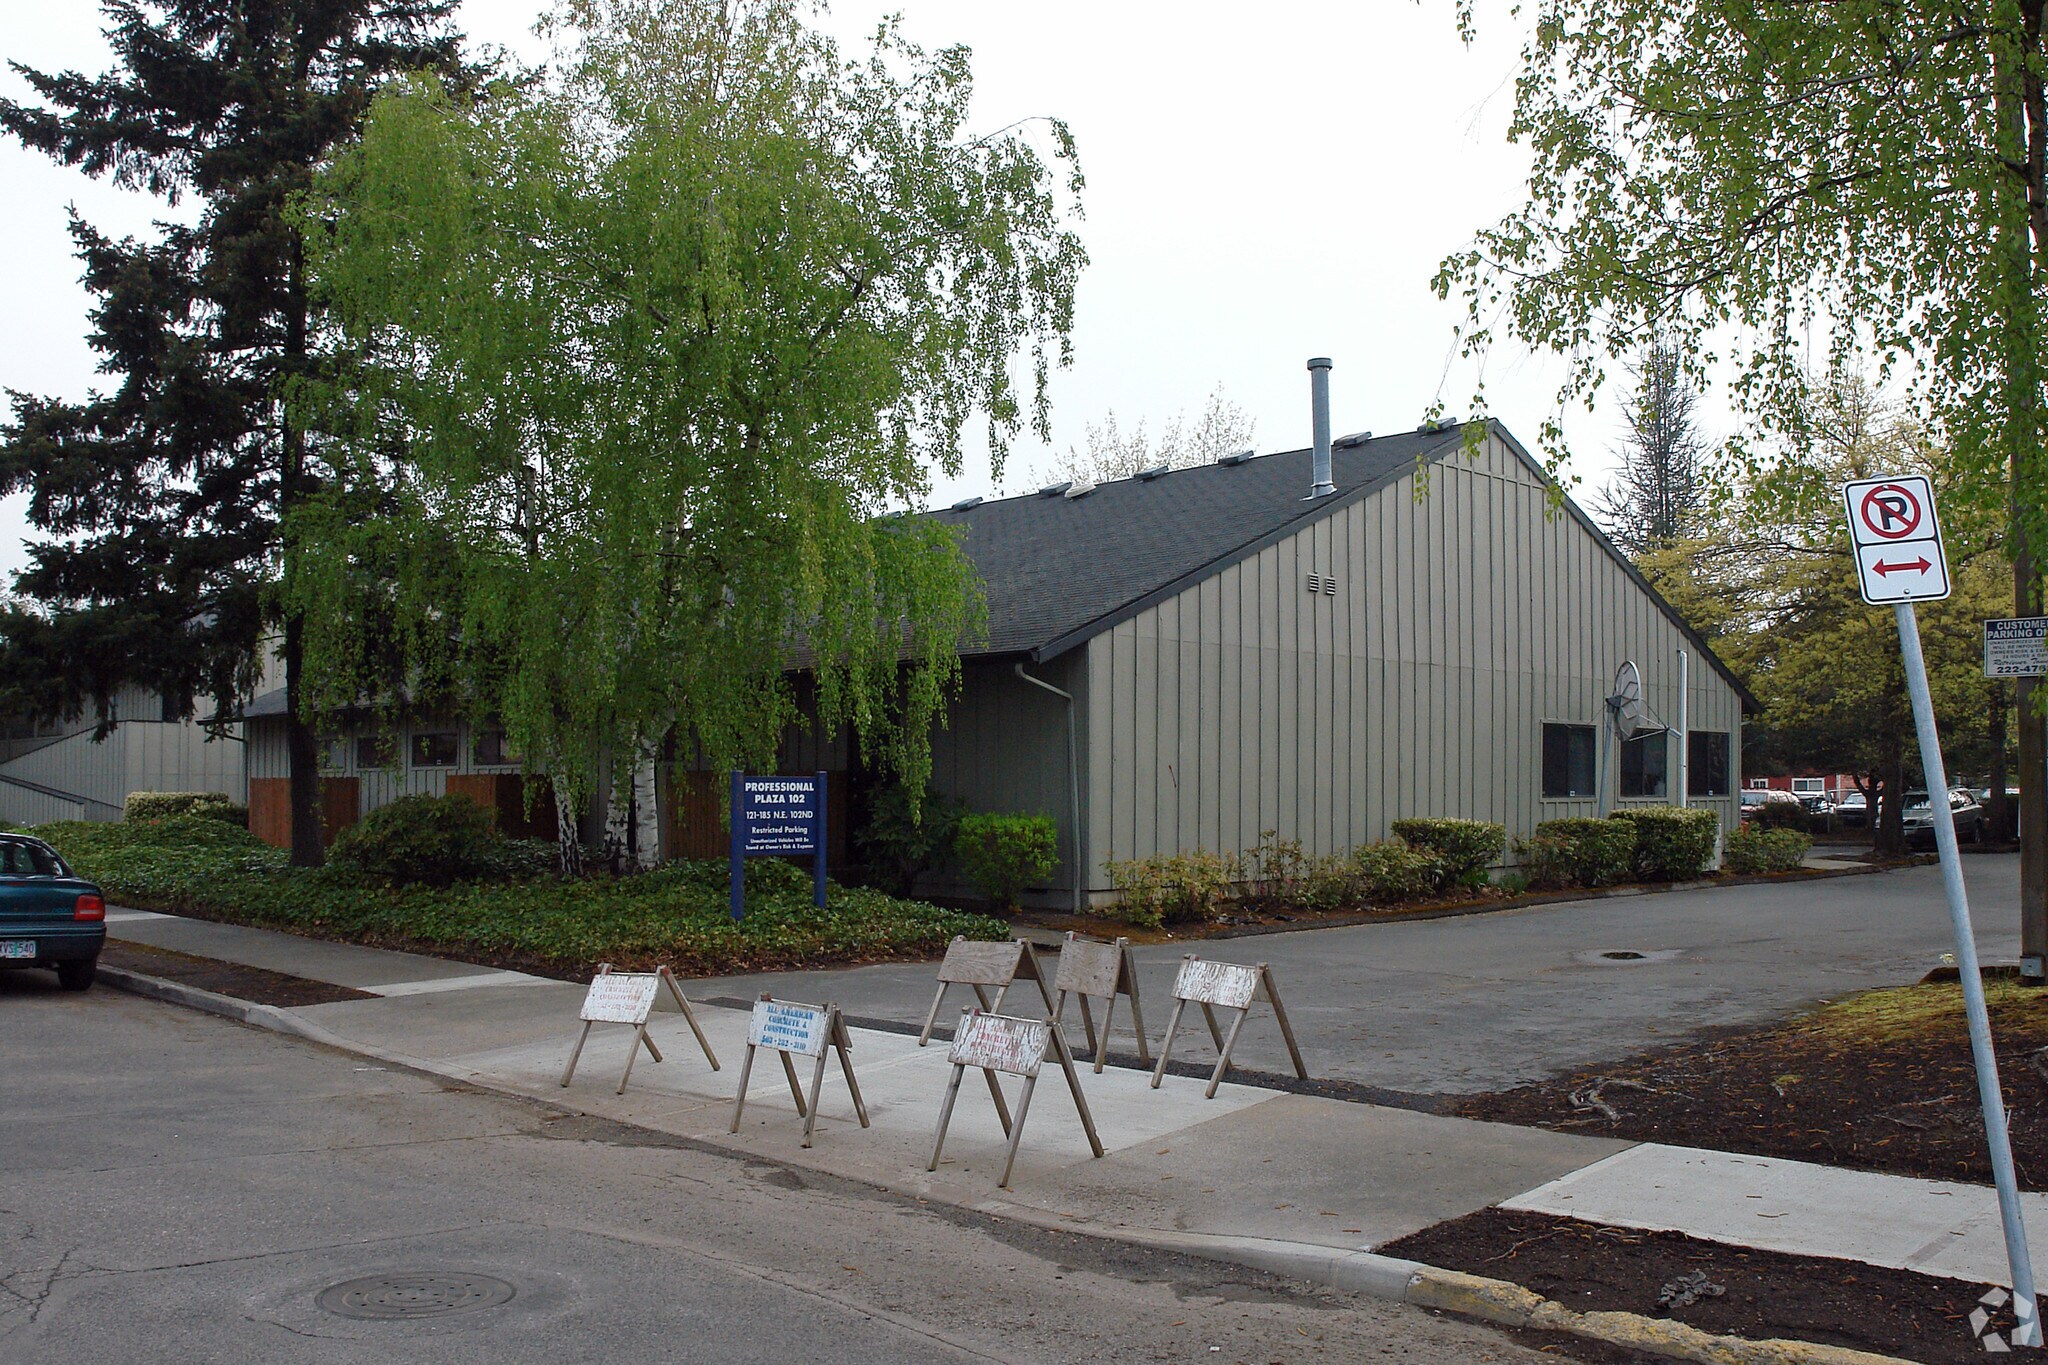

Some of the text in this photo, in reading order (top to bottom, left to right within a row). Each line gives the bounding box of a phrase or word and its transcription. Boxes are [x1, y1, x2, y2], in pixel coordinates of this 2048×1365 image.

[1997, 620, 2048, 630] CUSTOME
[1987, 629, 2033, 639] PARKING
[745, 782, 814, 792] PROFESSIONAL
[755, 794, 805, 804] PLAZA 102
[746, 810, 813, 819] 121-185 N.E. 102ND
[752, 826, 808, 835] Restricted Parking
[18, 943, 34, 954] 540
[767, 1004, 814, 1020] ALL AMERICAN
[769, 1015, 800, 1027] CONCRETE
[764, 1024, 809, 1039] CONSTRUCTION
